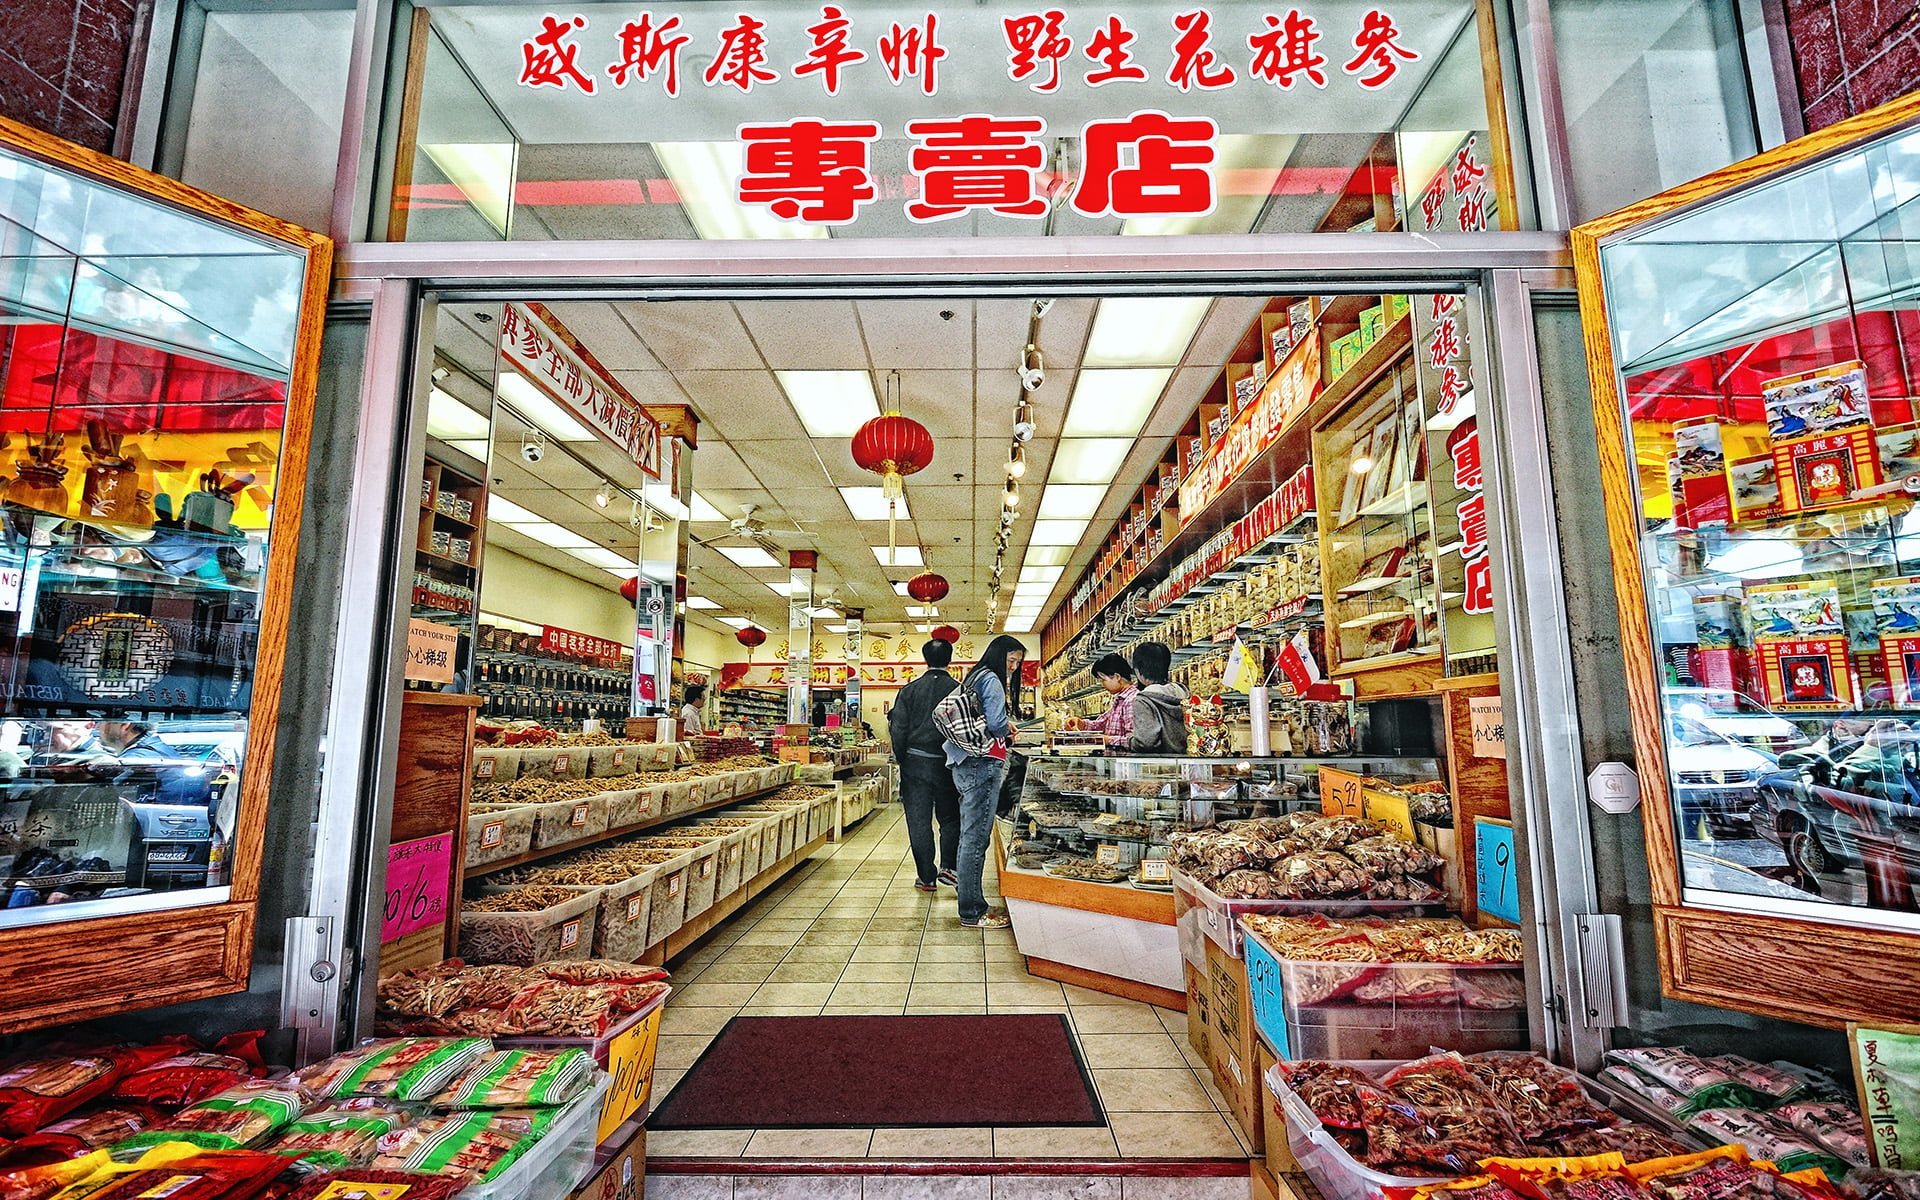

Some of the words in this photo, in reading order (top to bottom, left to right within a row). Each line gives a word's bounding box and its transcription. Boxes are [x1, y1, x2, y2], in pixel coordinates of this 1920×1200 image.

[521, 6, 946, 95] 威斯康辛州
[1003, 9, 1418, 91] 野生花旗參
[738, 112, 1216, 222] 專賣店
[410, 628, 427, 638] ATCH
